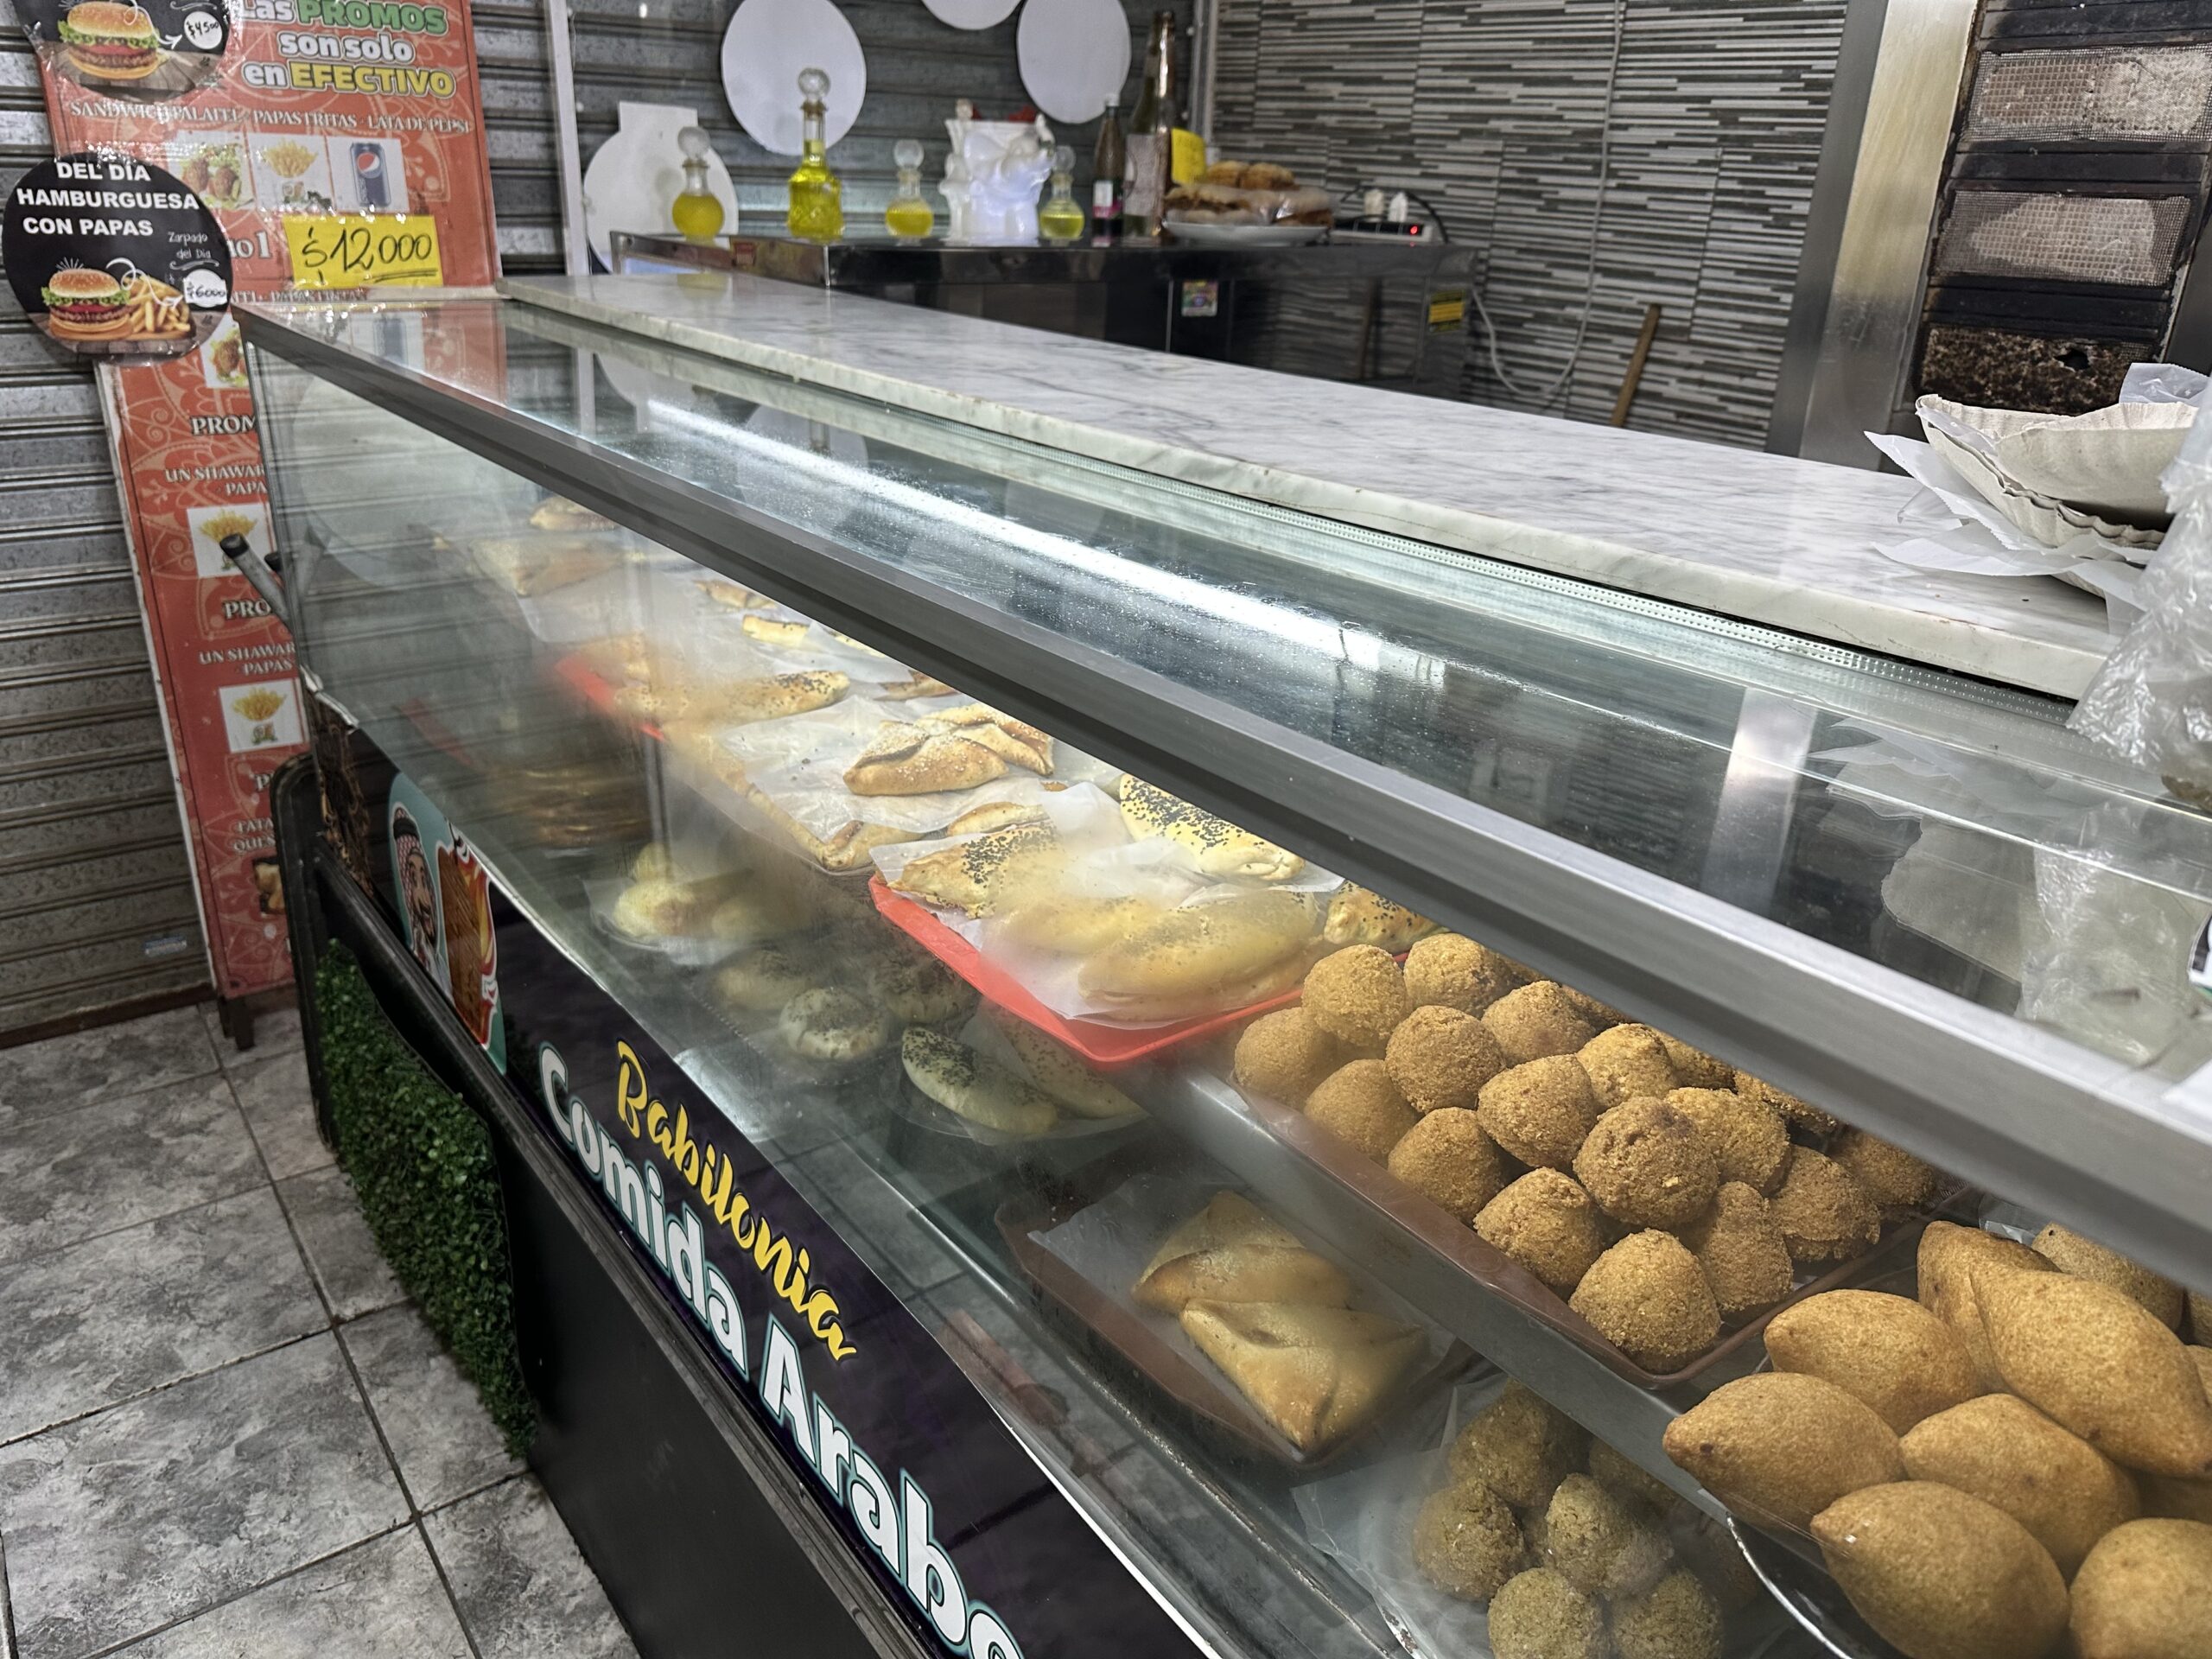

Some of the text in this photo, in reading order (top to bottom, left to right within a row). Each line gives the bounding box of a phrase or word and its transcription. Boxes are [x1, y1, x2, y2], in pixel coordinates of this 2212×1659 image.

[296, 0, 448, 35] PROMOS
[186, 21, 219, 39] $4500
[278, 32, 415, 63] son solo
[243, 60, 456, 99] en EFECTIVO
[252, 110, 302, 126] PAPAS
[304, 111, 358, 127] FRITAS
[367, 114, 405, 130] LATA
[406, 116, 429, 131] DE
[430, 118, 471, 134] PEPSI
[56, 162, 103, 180] DEL
[16, 188, 200, 210] HAMBURGUESA
[22, 217, 154, 236] CON PAPAS
[164, 467, 191, 483] UN
[199, 650, 225, 664] UN
[243, 659, 294, 676] PAPAS
[539, 1040, 749, 1382] Comida
